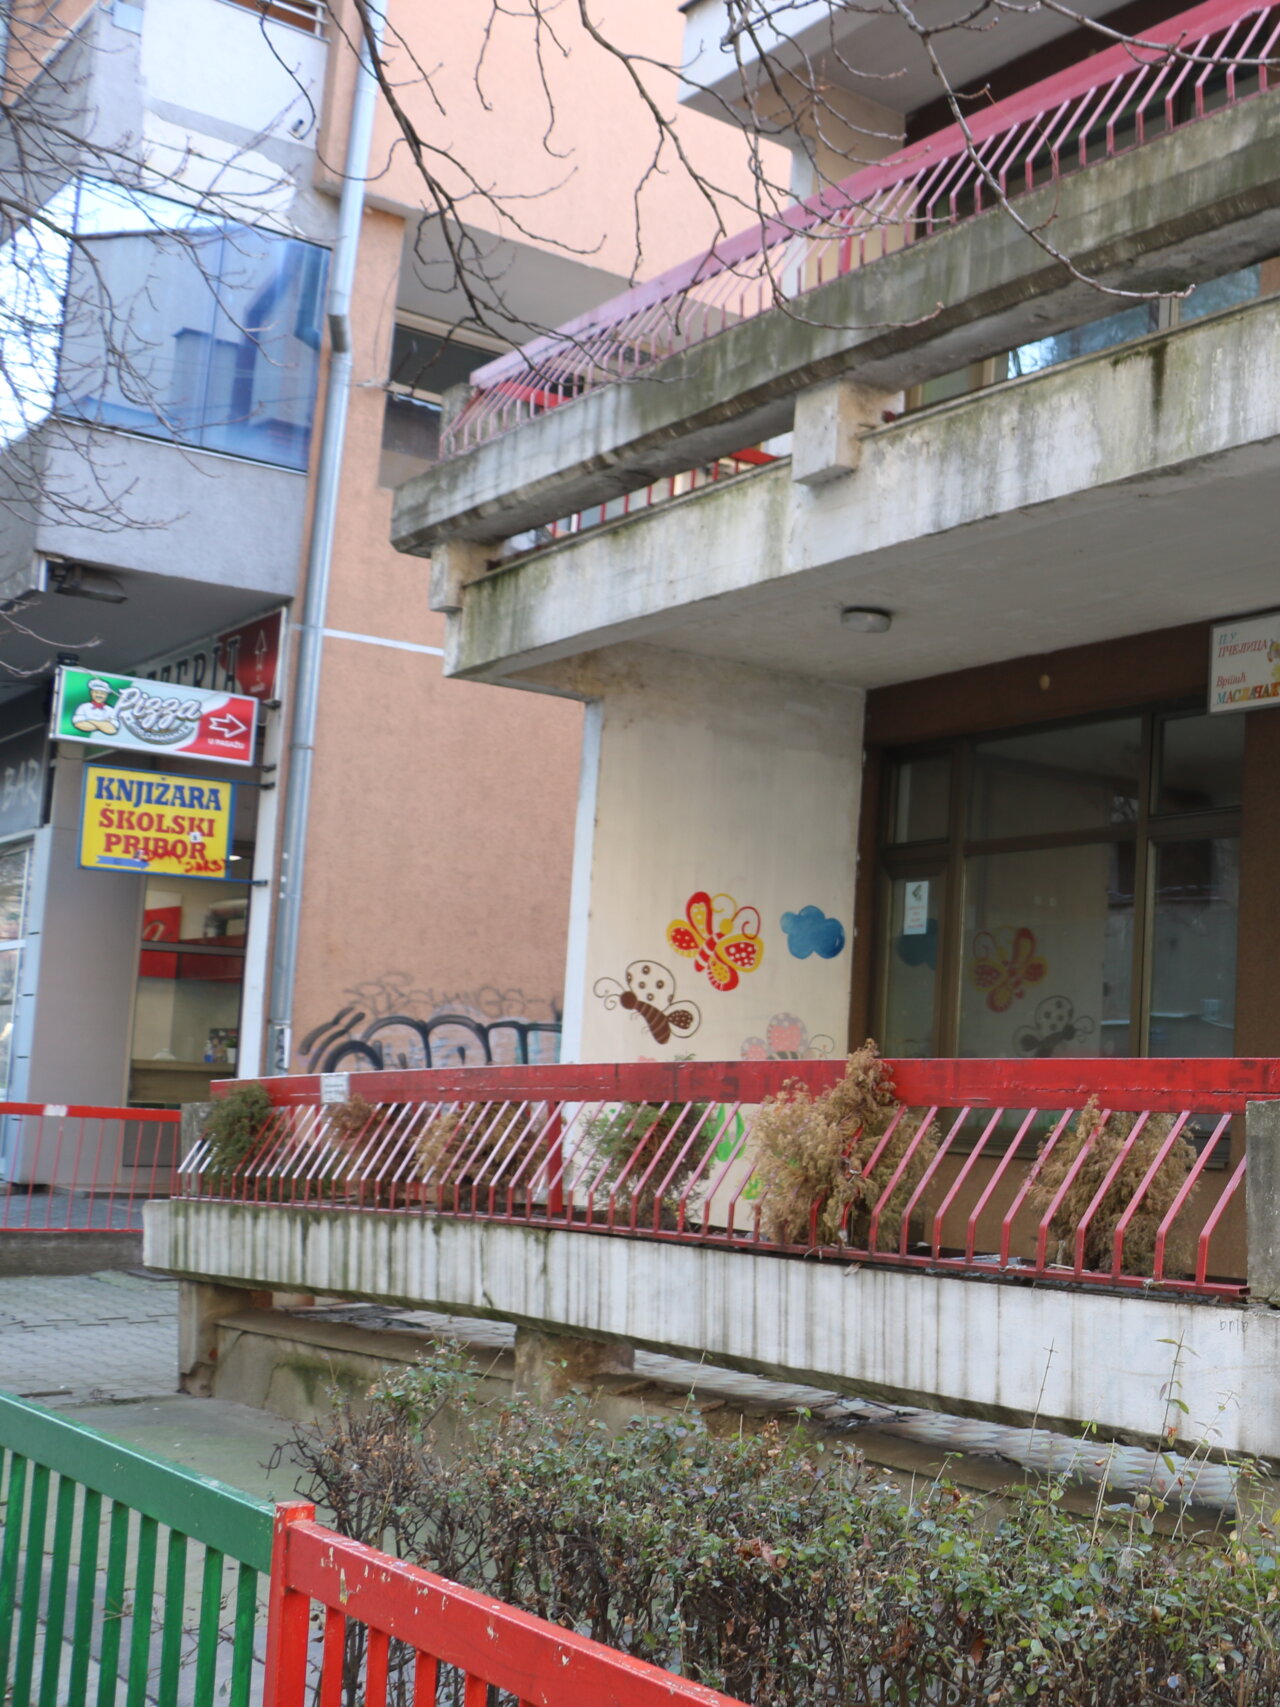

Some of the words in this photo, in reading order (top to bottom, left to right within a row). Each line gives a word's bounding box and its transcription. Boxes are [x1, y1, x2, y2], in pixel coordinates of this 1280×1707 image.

[115, 687, 202, 729] Pizza
[94, 775, 222, 811] KNJIŽARA
[98, 803, 216, 838] ŠKOLSKI
[103, 832, 207, 861] PRIBOR
